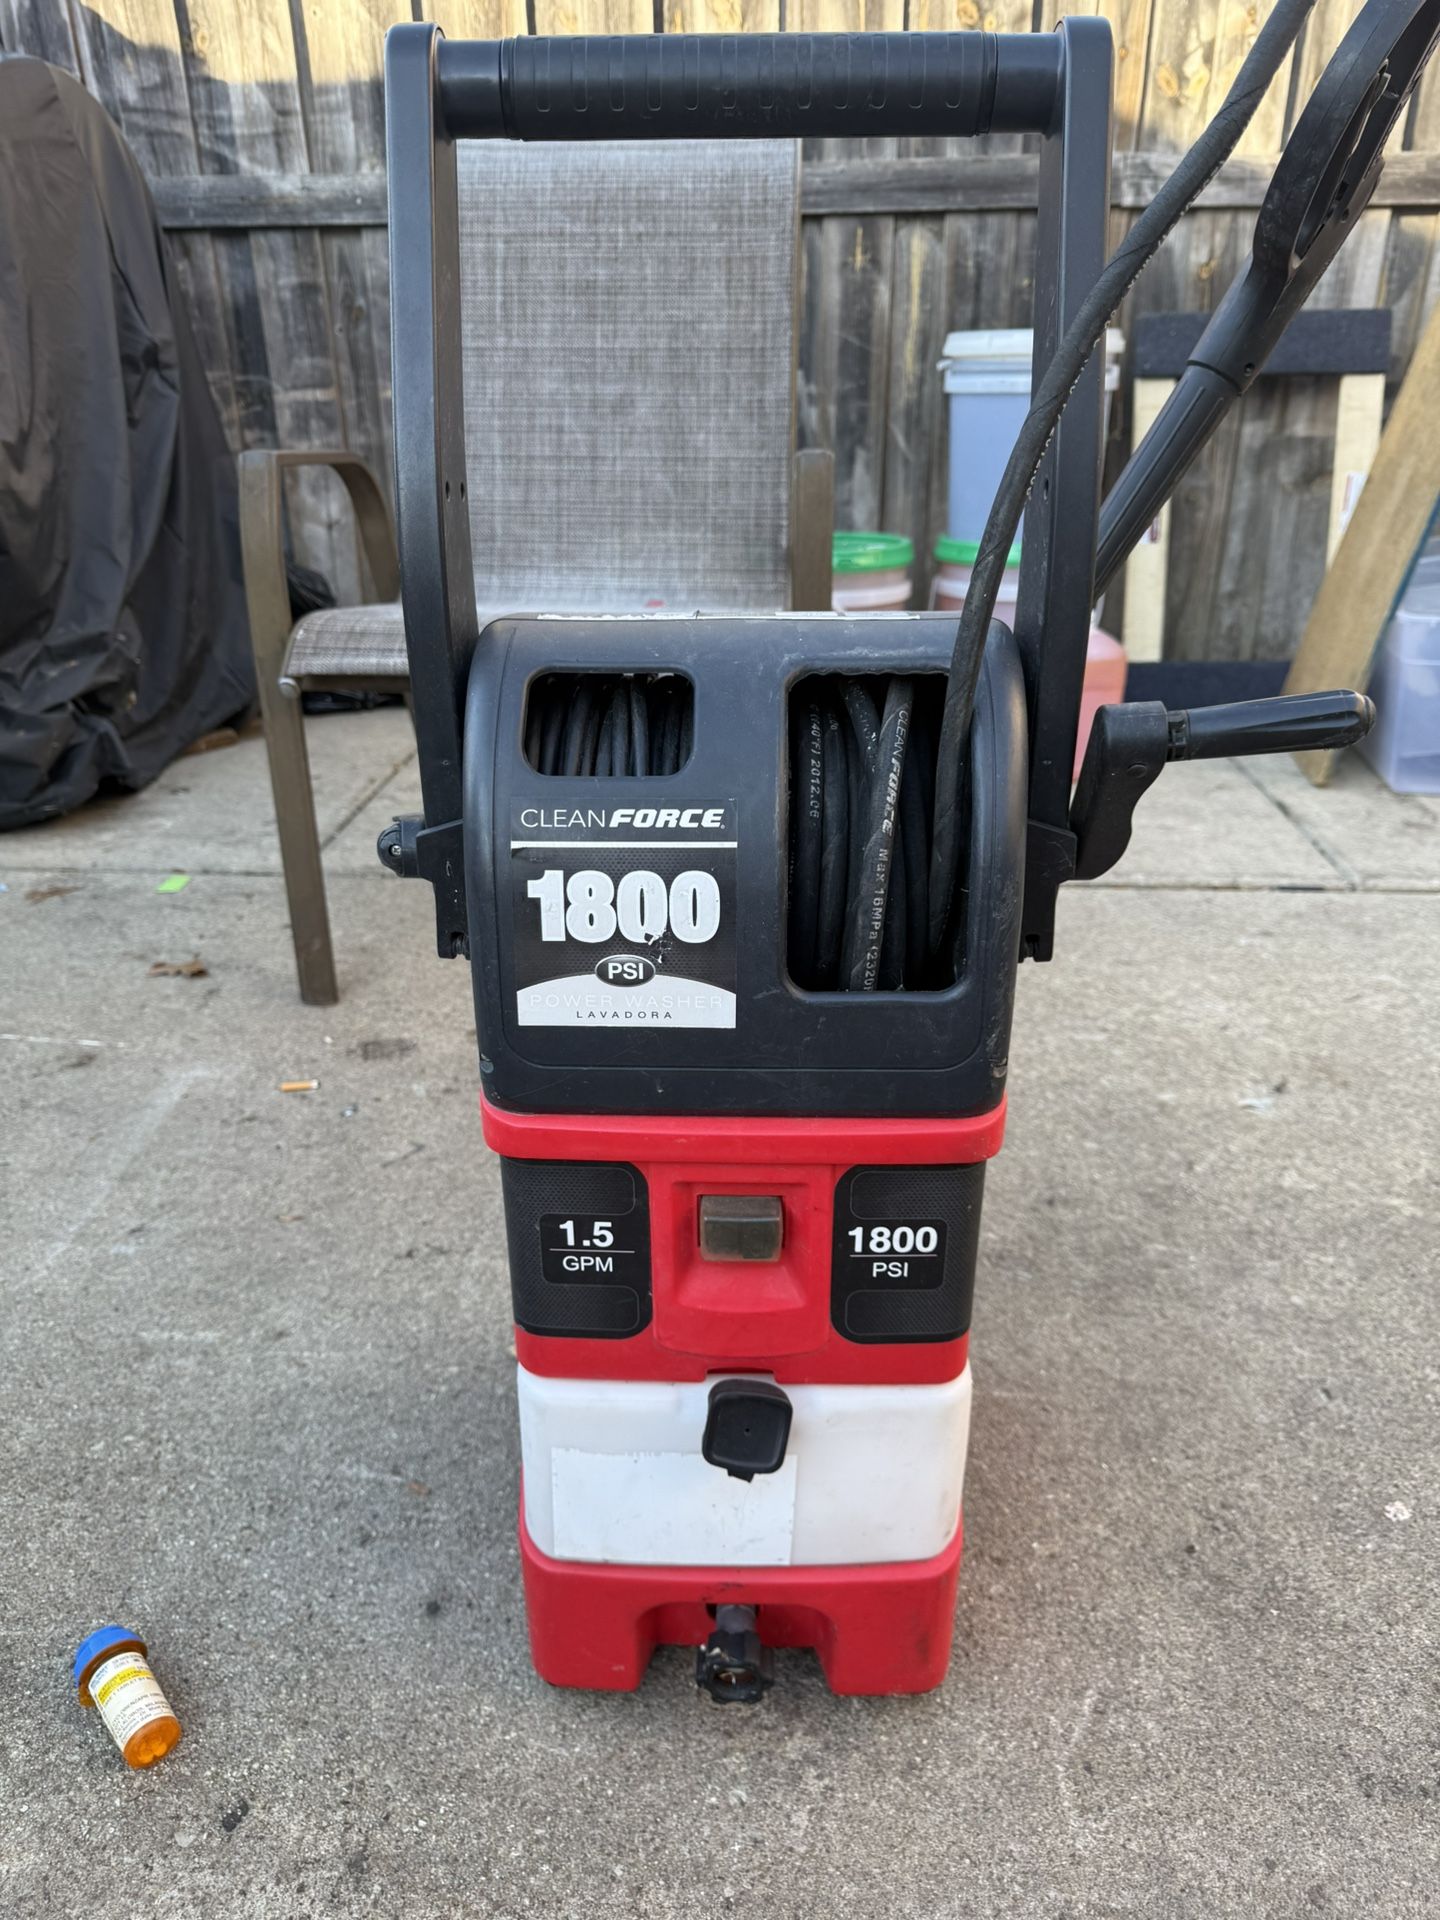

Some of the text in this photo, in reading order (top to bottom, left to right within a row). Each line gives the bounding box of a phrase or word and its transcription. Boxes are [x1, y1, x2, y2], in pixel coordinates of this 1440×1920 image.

[875, 848, 889, 881] Max
[527, 869, 721, 944] 1800
[607, 962, 644, 980] PSI
[530, 994, 722, 1009] POWER WASHER
[576, 1010, 673, 1020] LAVADORA
[558, 1220, 615, 1247] 1.5
[847, 1226, 938, 1254] 1800
[562, 1255, 614, 1273] GPM
[871, 1261, 909, 1278] PSI
